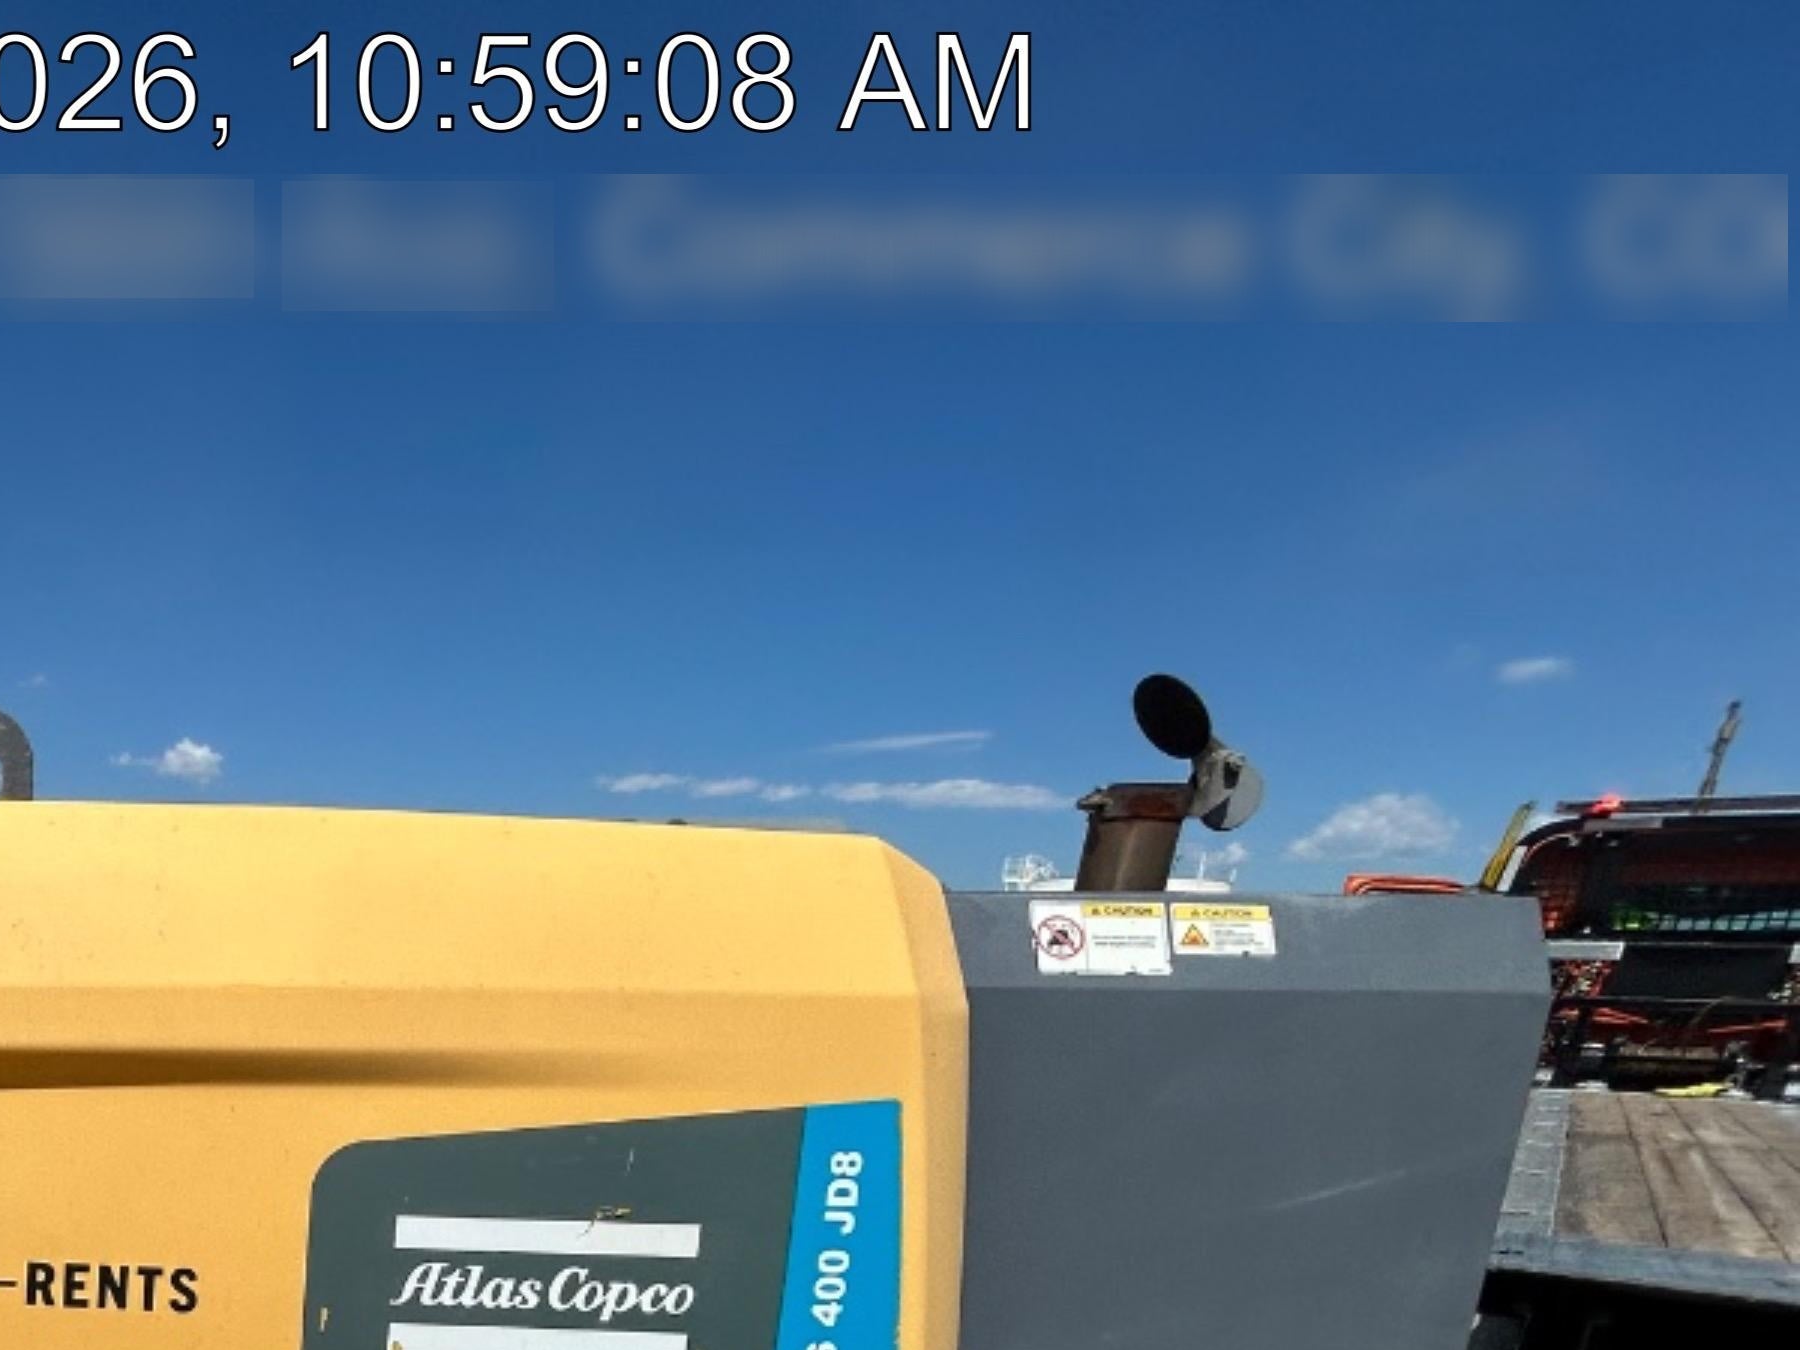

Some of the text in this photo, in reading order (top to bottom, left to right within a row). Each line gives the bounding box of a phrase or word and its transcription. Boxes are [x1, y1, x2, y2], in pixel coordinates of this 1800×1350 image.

[1104, 904, 1153, 916] CAUTION
[823, 1150, 865, 1236] JD8
[390, 1262, 696, 1322] Atlas Copco
[811, 1249, 851, 1328] 400
